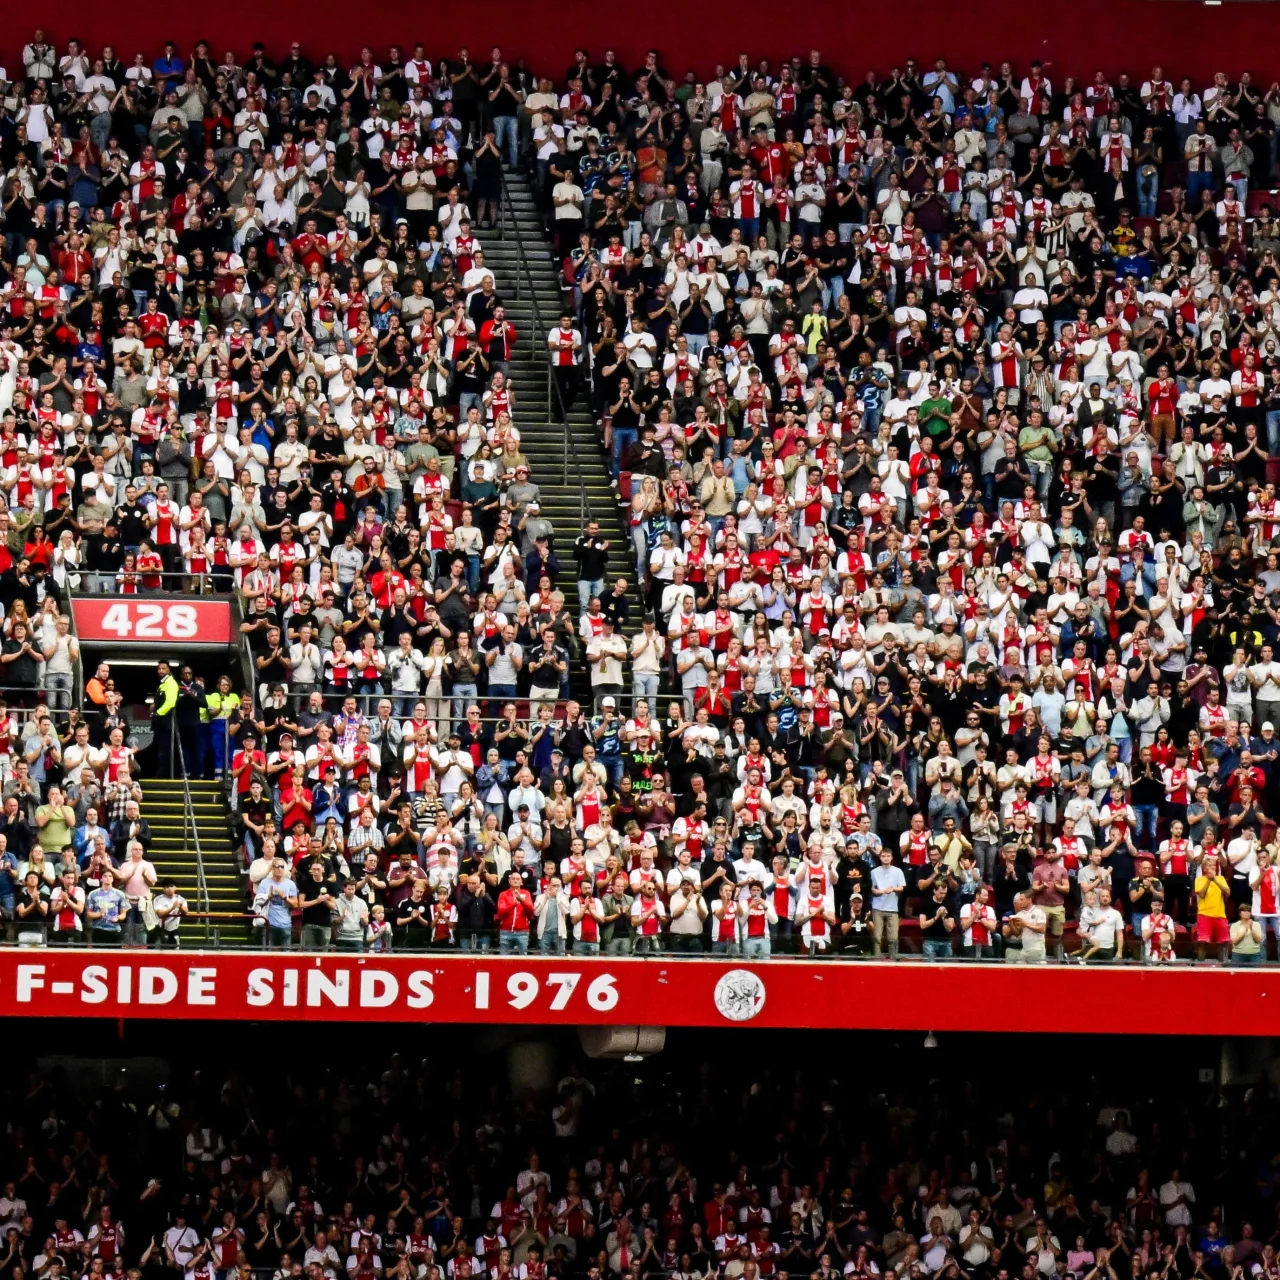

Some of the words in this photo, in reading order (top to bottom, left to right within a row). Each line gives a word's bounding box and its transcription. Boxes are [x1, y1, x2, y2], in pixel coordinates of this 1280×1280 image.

[101, 603, 199, 638] 428
[16, 964, 217, 1005] F-SIDE
[246, 967, 435, 1009] SINDS
[474, 971, 619, 1012] 1976
